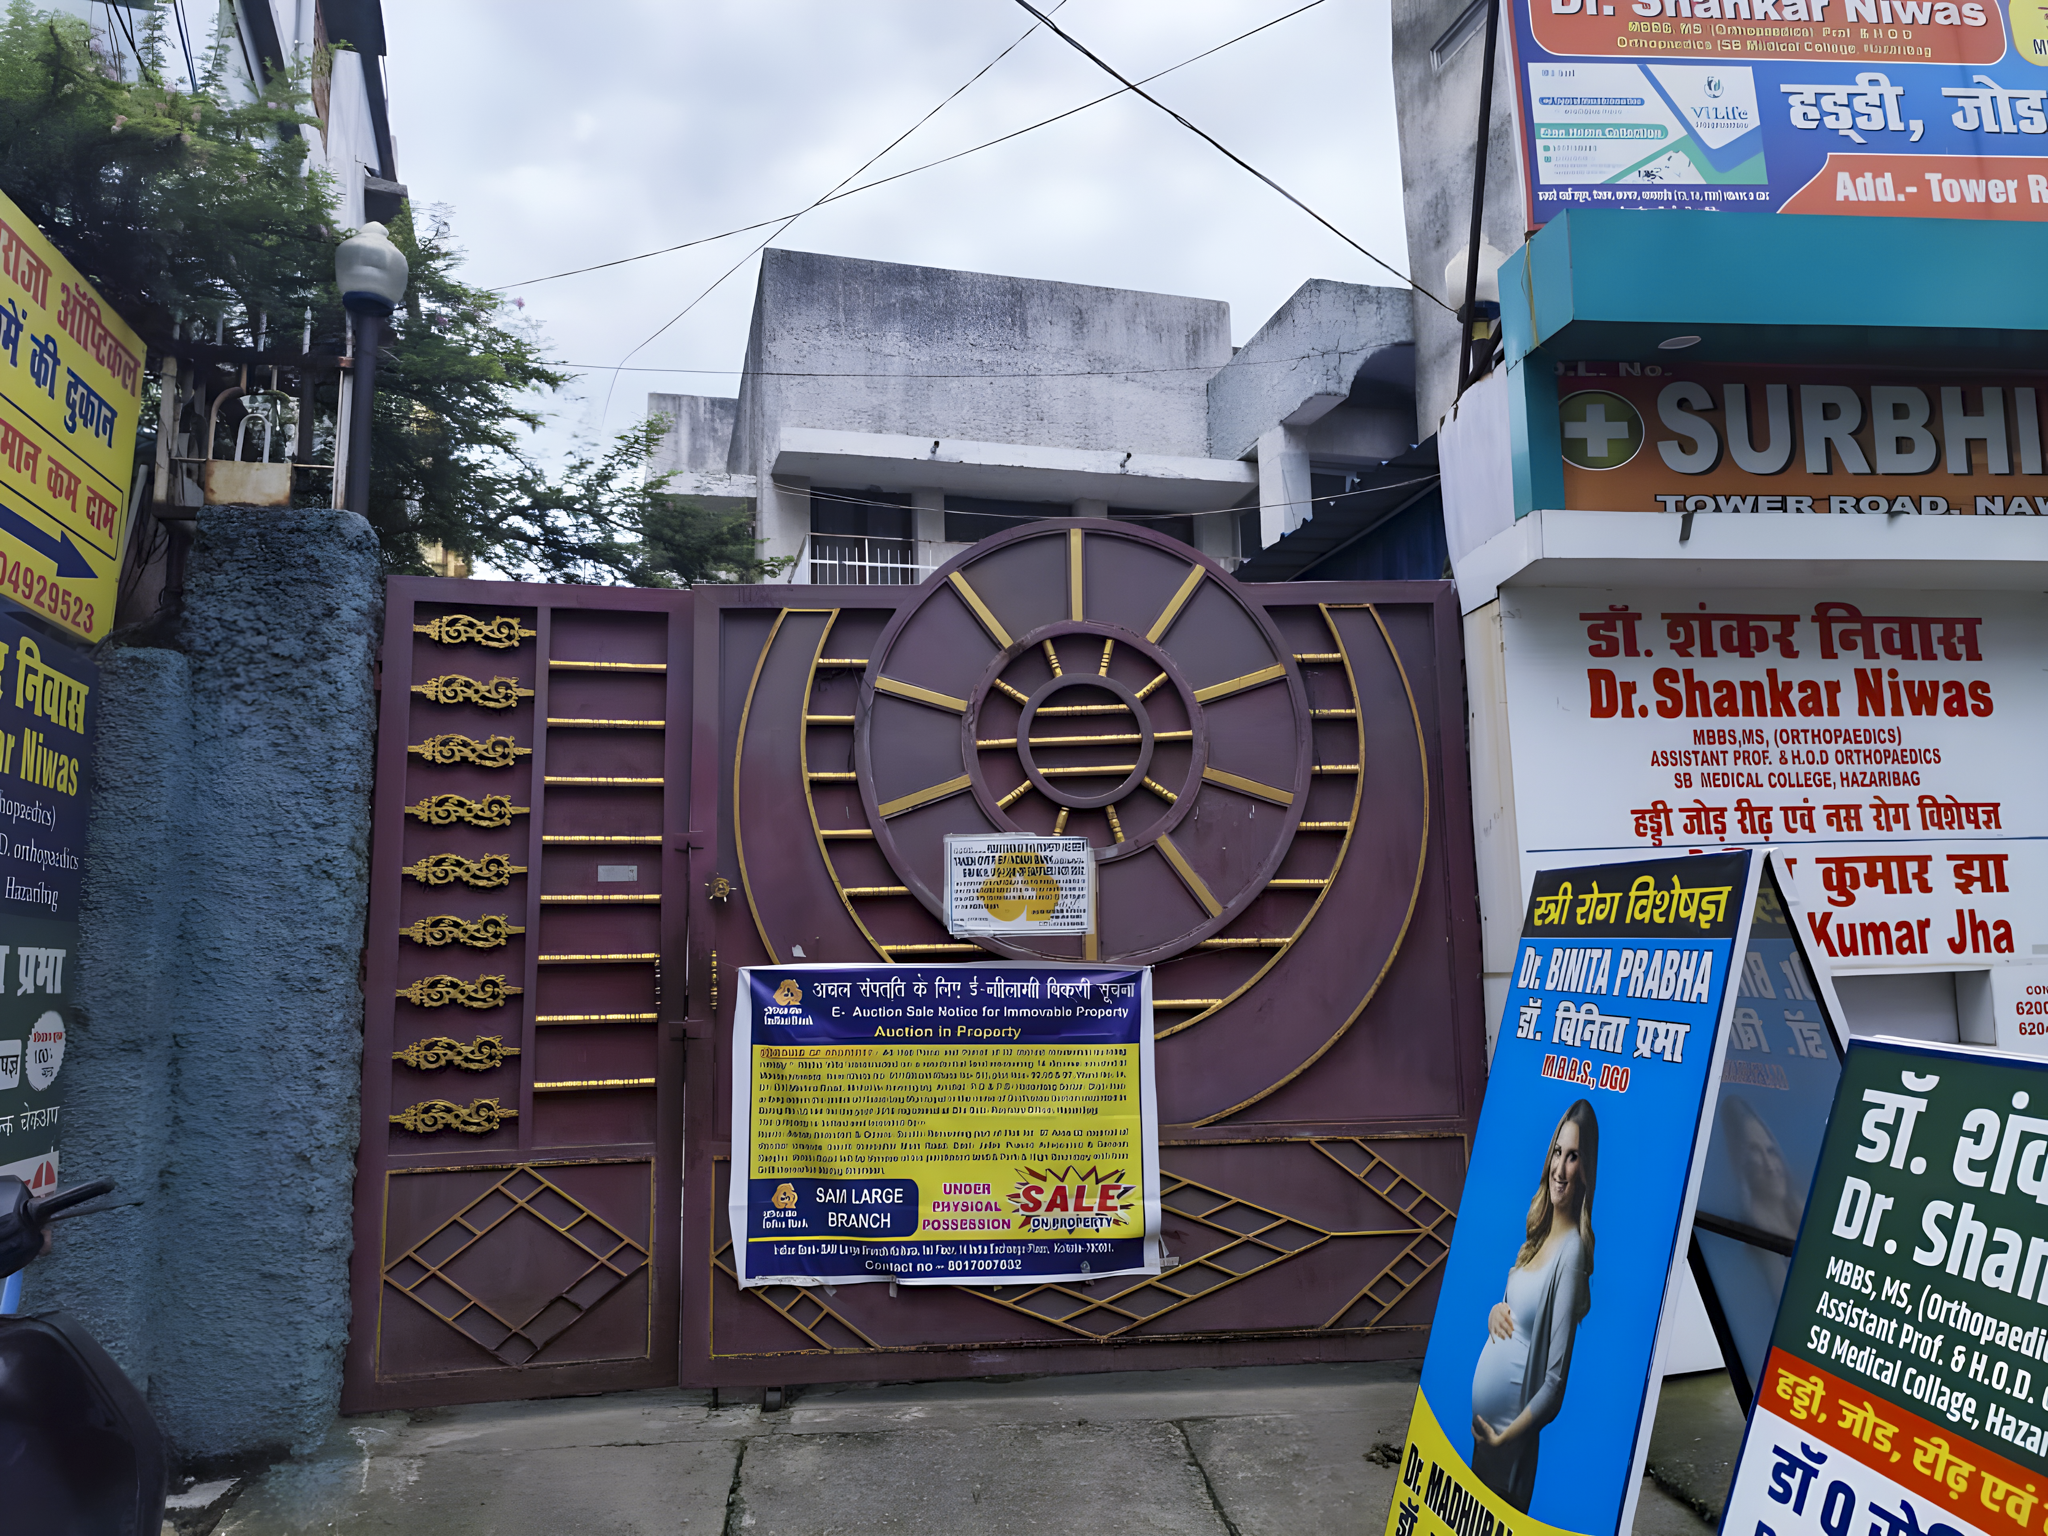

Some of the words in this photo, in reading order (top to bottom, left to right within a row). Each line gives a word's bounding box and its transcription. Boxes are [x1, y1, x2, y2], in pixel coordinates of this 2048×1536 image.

[1925, 173, 2018, 204] Tower
[30, 334, 61, 400] की
[65, 366, 118, 448] दुकान
[1657, 380, 2046, 476] SURBHI
[47, 455, 82, 513] कम
[86, 485, 118, 539] दाम
[1655, 494, 1818, 513] TOWER
[1579, 604, 1653, 659] डॉ.
[1661, 602, 1801, 659] शंकर
[1811, 602, 1984, 662] निवास
[15, 636, 90, 735] निवास
[1853, 667, 1995, 719] Niwas
[20, 727, 79, 797] Niwas
[1651, 750, 1729, 767] ASSISTANT
[1733, 750, 1773, 766] PROF.
[1834, 747, 1942, 765] ORTHOPAEDICS
[1774, 725, 1902, 747] (ORTHOPAEDICS)
[1674, 773, 1693, 789] SB
[1700, 772, 1764, 789] MEDICAL
[1768, 772, 1836, 789] COLLEGE,
[1840, 770, 1921, 788] HAZARIBAG
[1779, 797, 1816, 834] एवं
[1823, 804, 1864, 832] नस
[1869, 796, 1912, 832] रोग
[1917, 794, 2002, 832] विशेषज्ञ
[1533, 881, 1573, 927] स्त्री
[1576, 880, 1623, 926] रोग
[1625, 874, 1733, 930] विशेषज्ञ
[1815, 853, 1934, 908] कुमार
[1946, 853, 2010, 895] झा
[1807, 911, 1931, 959] Kumar
[1948, 908, 2016, 955] Jha
[17, 946, 67, 997] प्रभा
[1517, 946, 1543, 990] Dr.
[1545, 947, 1613, 995] BINITA
[1612, 948, 1714, 1004] PRABHA
[874, 1025, 933, 1038] Auction
[938, 1025, 952, 1038] in
[938, 1005, 978, 1018] Notice
[982, 1006, 1000, 1018] for
[1516, 997, 1542, 1041] डॉ.
[1633, 1018, 1691, 1063] प्रभा
[1855, 1070, 1940, 1175] डॉ.
[852, 1187, 904, 1204] LARGE
[932, 1200, 1003, 1213] PHYSICAL
[942, 1182, 992, 1196] UNDER
[1020, 1183, 1122, 1213] SALE
[1831, 1175, 1898, 1255] Dr.
[828, 1211, 891, 1229] BRANCH
[922, 1218, 1012, 1231] POSSESSION
[1825, 1255, 1877, 1301] MBBS,
[1881, 1275, 1913, 1315] MS,
[1815, 1290, 1899, 1345] Assistant
[1898, 1322, 1945, 1366] Prof.
[1950, 1345, 1967, 1373] &
[1968, 1351, 2034, 1404] H.O.D.
[1806, 1324, 1832, 1355] SB
[1830, 1335, 1902, 1388] Medical
[1902, 1366, 1981, 1431] Collage,
[1403, 1441, 1425, 1496] Dr.
[1979, 1470, 2039, 1528] एवं
